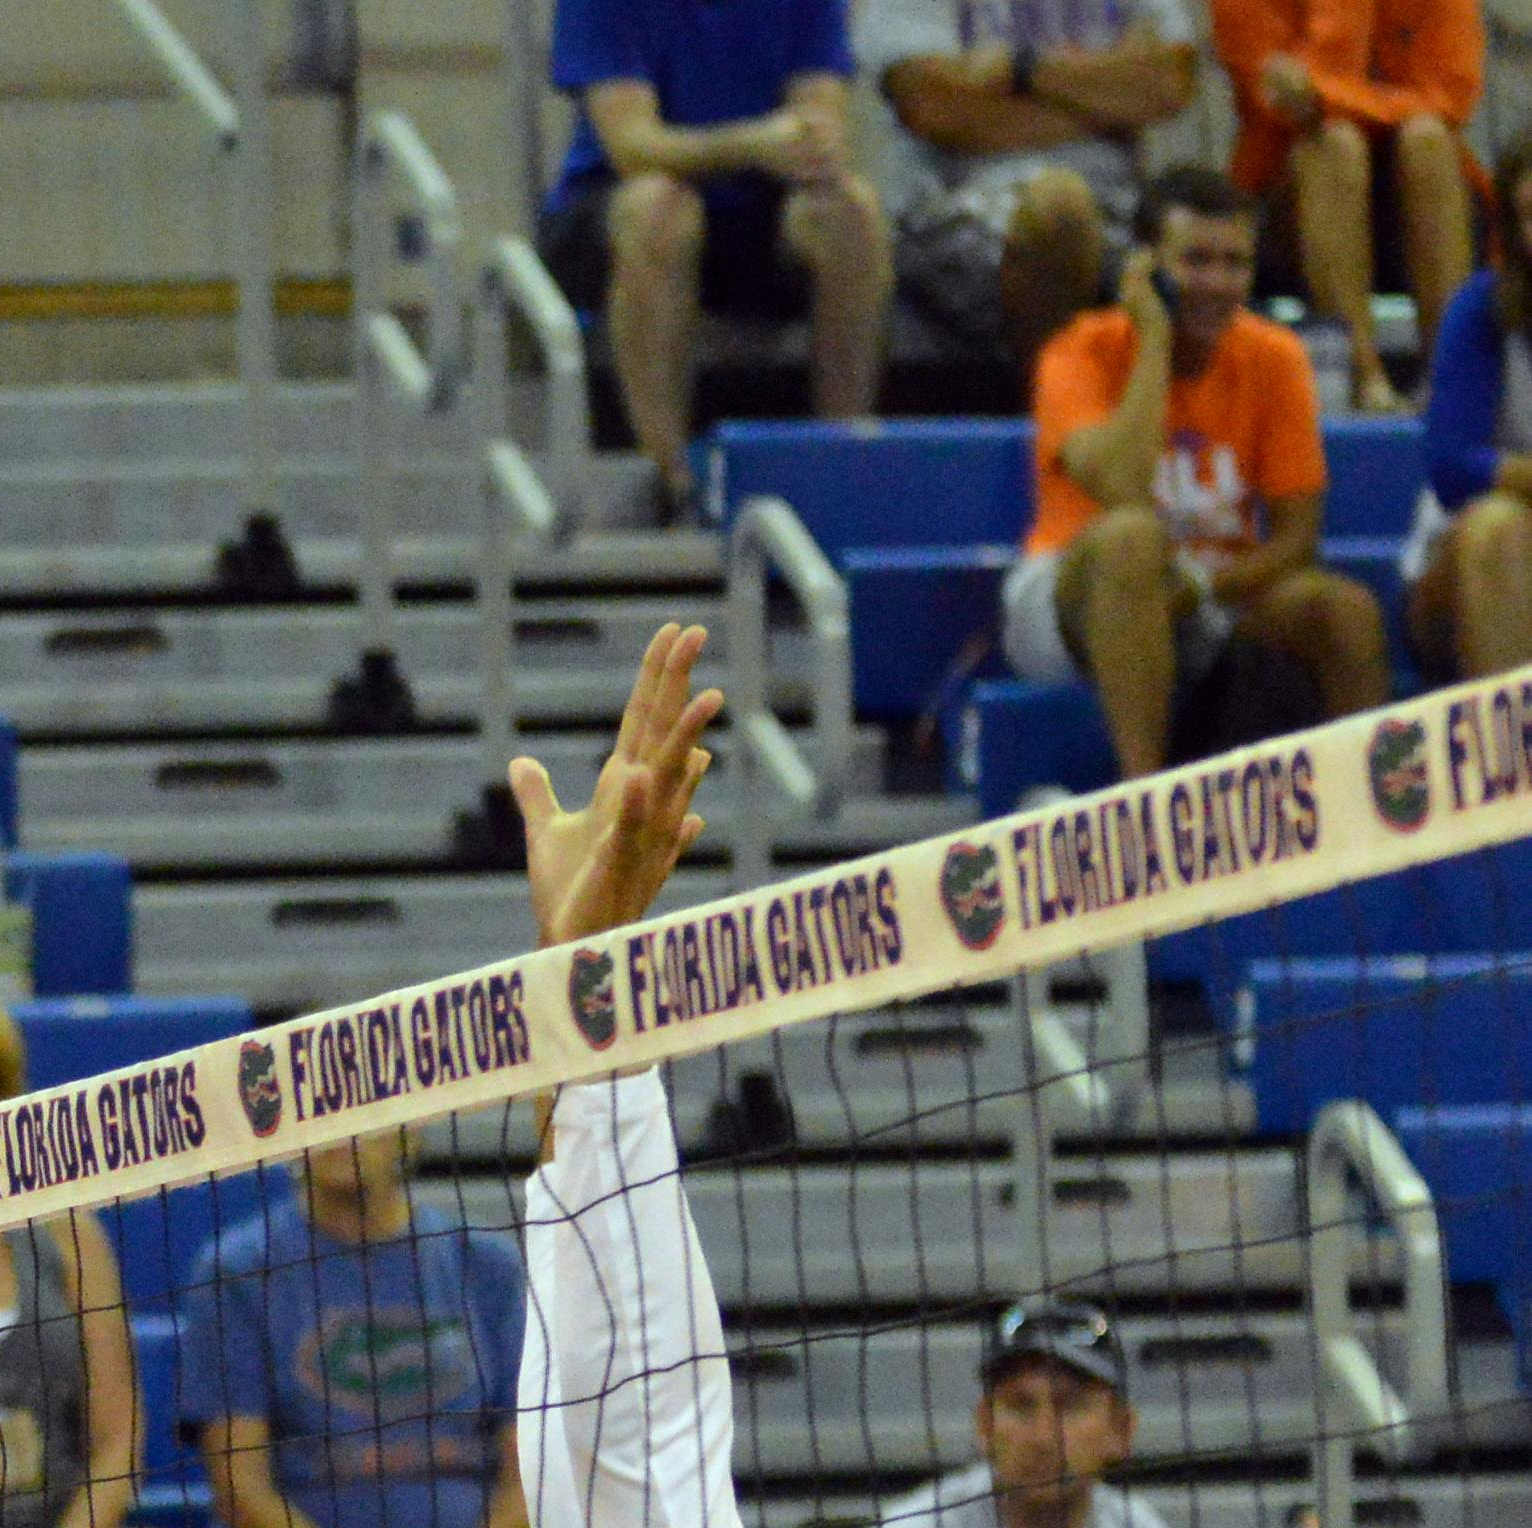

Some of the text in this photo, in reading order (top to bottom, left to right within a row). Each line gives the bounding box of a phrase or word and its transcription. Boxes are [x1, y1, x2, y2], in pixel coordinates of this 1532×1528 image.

[1013, 748, 1321, 930] FLORIDA GATORS
[627, 866, 904, 1033] FLORIDA GATORS
[97, 1060, 206, 1171] GATORS
[288, 969, 531, 1122] FLORIDA GATORS
